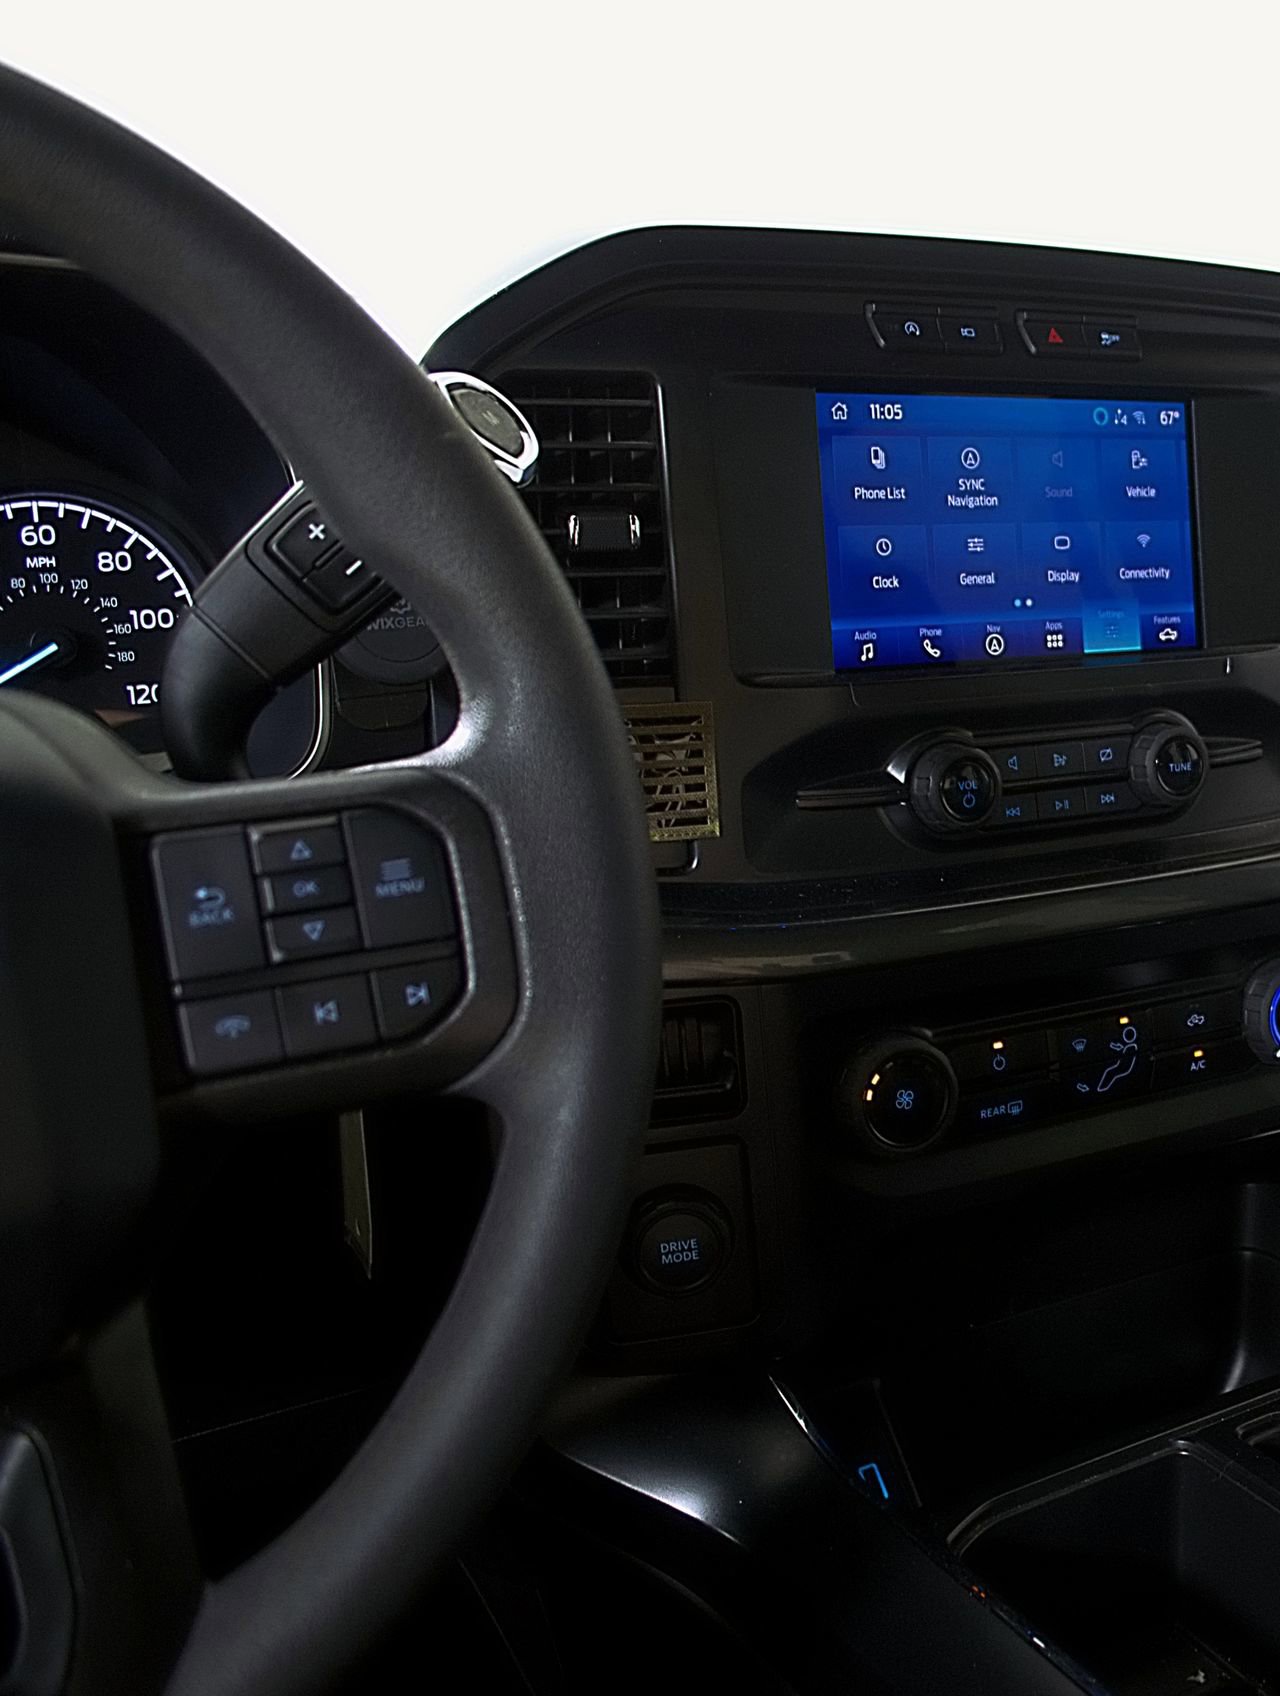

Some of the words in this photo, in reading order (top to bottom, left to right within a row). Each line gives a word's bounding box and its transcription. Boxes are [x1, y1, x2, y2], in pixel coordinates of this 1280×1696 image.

[868, 404, 903, 420] 11:05
[958, 479, 985, 491] SYNC
[854, 487, 886, 501] Phone
[887, 487, 906, 500] List
[1045, 486, 1073, 499] Sound
[1126, 486, 1156, 498] Vehicle
[947, 494, 998, 508] Navigation
[20, 525, 56, 546] 60
[26, 556, 56, 568] MPH
[97, 551, 132, 573] 80
[40, 573, 59, 585] 100
[959, 572, 995, 585] General
[1047, 570, 1080, 583] Display
[1119, 567, 1170, 580] Connectivity
[10, 577, 26, 590] 80
[71, 578, 89, 591] 120
[872, 576, 899, 588] Clock
[100, 597, 118, 608] 140
[129, 608, 174, 630] 100
[1153, 616, 1181, 624] Features
[113, 623, 132, 635] 160
[919, 628, 942, 637] Phone
[986, 625, 1000, 633] Nav
[1045, 622, 1063, 632] Apps
[854, 632, 877, 641] Audio
[117, 651, 135, 663] 180
[1168, 763, 1192, 773] TUNE
[957, 781, 979, 790] VOL
[293, 880, 319, 896] OK
[375, 879, 425, 897] MENU
[189, 910, 235, 927] BACK
[1190, 1060, 1206, 1071] A/C
[980, 1105, 1006, 1119] REAR
[660, 1239, 698, 1253] DRIVE
[662, 1250, 700, 1264] MODE
